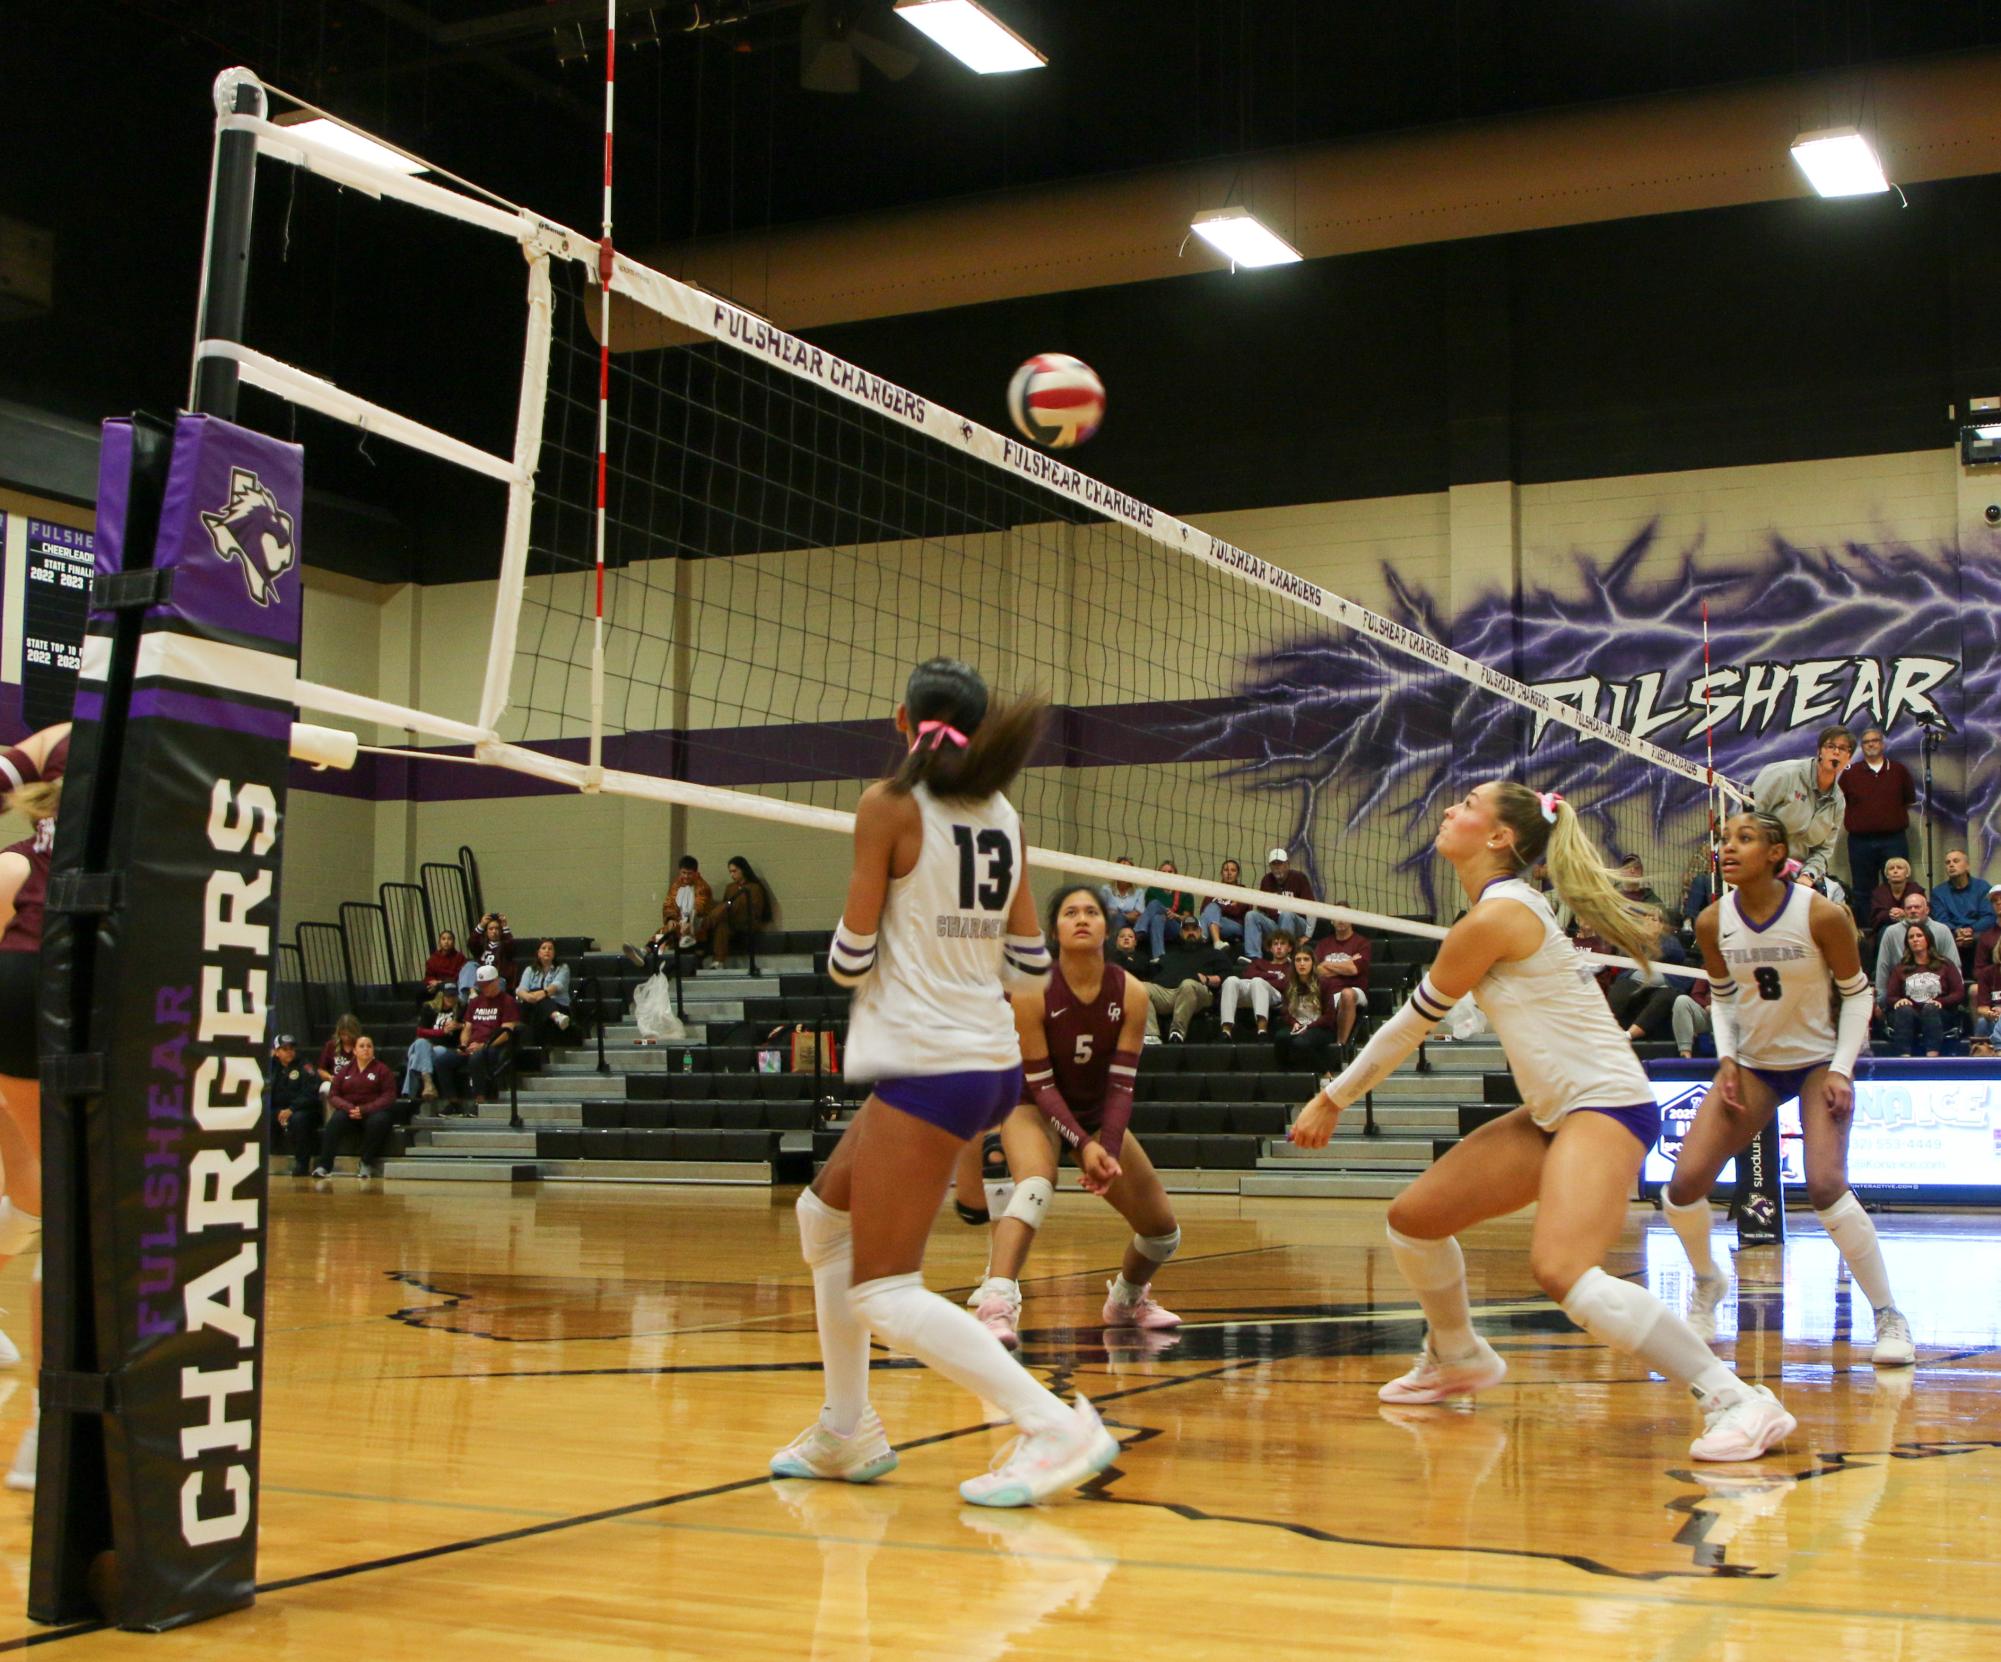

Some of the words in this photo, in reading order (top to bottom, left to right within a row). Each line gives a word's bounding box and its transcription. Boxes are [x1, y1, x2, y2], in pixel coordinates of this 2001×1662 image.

[713, 304, 823, 378] FULSHEAR
[830, 356, 926, 424] CHARGERS
[1003, 438, 1081, 496] FULSHEAR
[1085, 477, 1154, 528] CHARGERS
[31, 522, 94, 548] FULSHE
[30, 566, 55, 583] 2022
[60, 573, 84, 590] 2023
[44, 558, 66, 572] STATE
[1209, 538, 1266, 580] FULSHEAR
[1269, 567, 1322, 606] CHARGERS
[26, 637, 48, 650] STATE
[50, 641, 65, 654] TOP
[68, 645, 77, 656] 10
[1363, 611, 1406, 646] FULSHEAR
[1408, 633, 1449, 664] CHARGERS
[27, 649, 51, 665] 2022
[57, 654, 80, 670] 2023
[952, 824, 1013, 911] 13
[936, 915, 1006, 939] CHARGE
[1753, 966, 1782, 1001] 8
[1107, 1002, 1121, 1021] CR
[1073, 1034, 1094, 1064] 5
[138, 984, 193, 1339] FULSHEAR
[180, 778, 278, 1547] CHARGERS
[1751, 1142, 1763, 1188] imports
